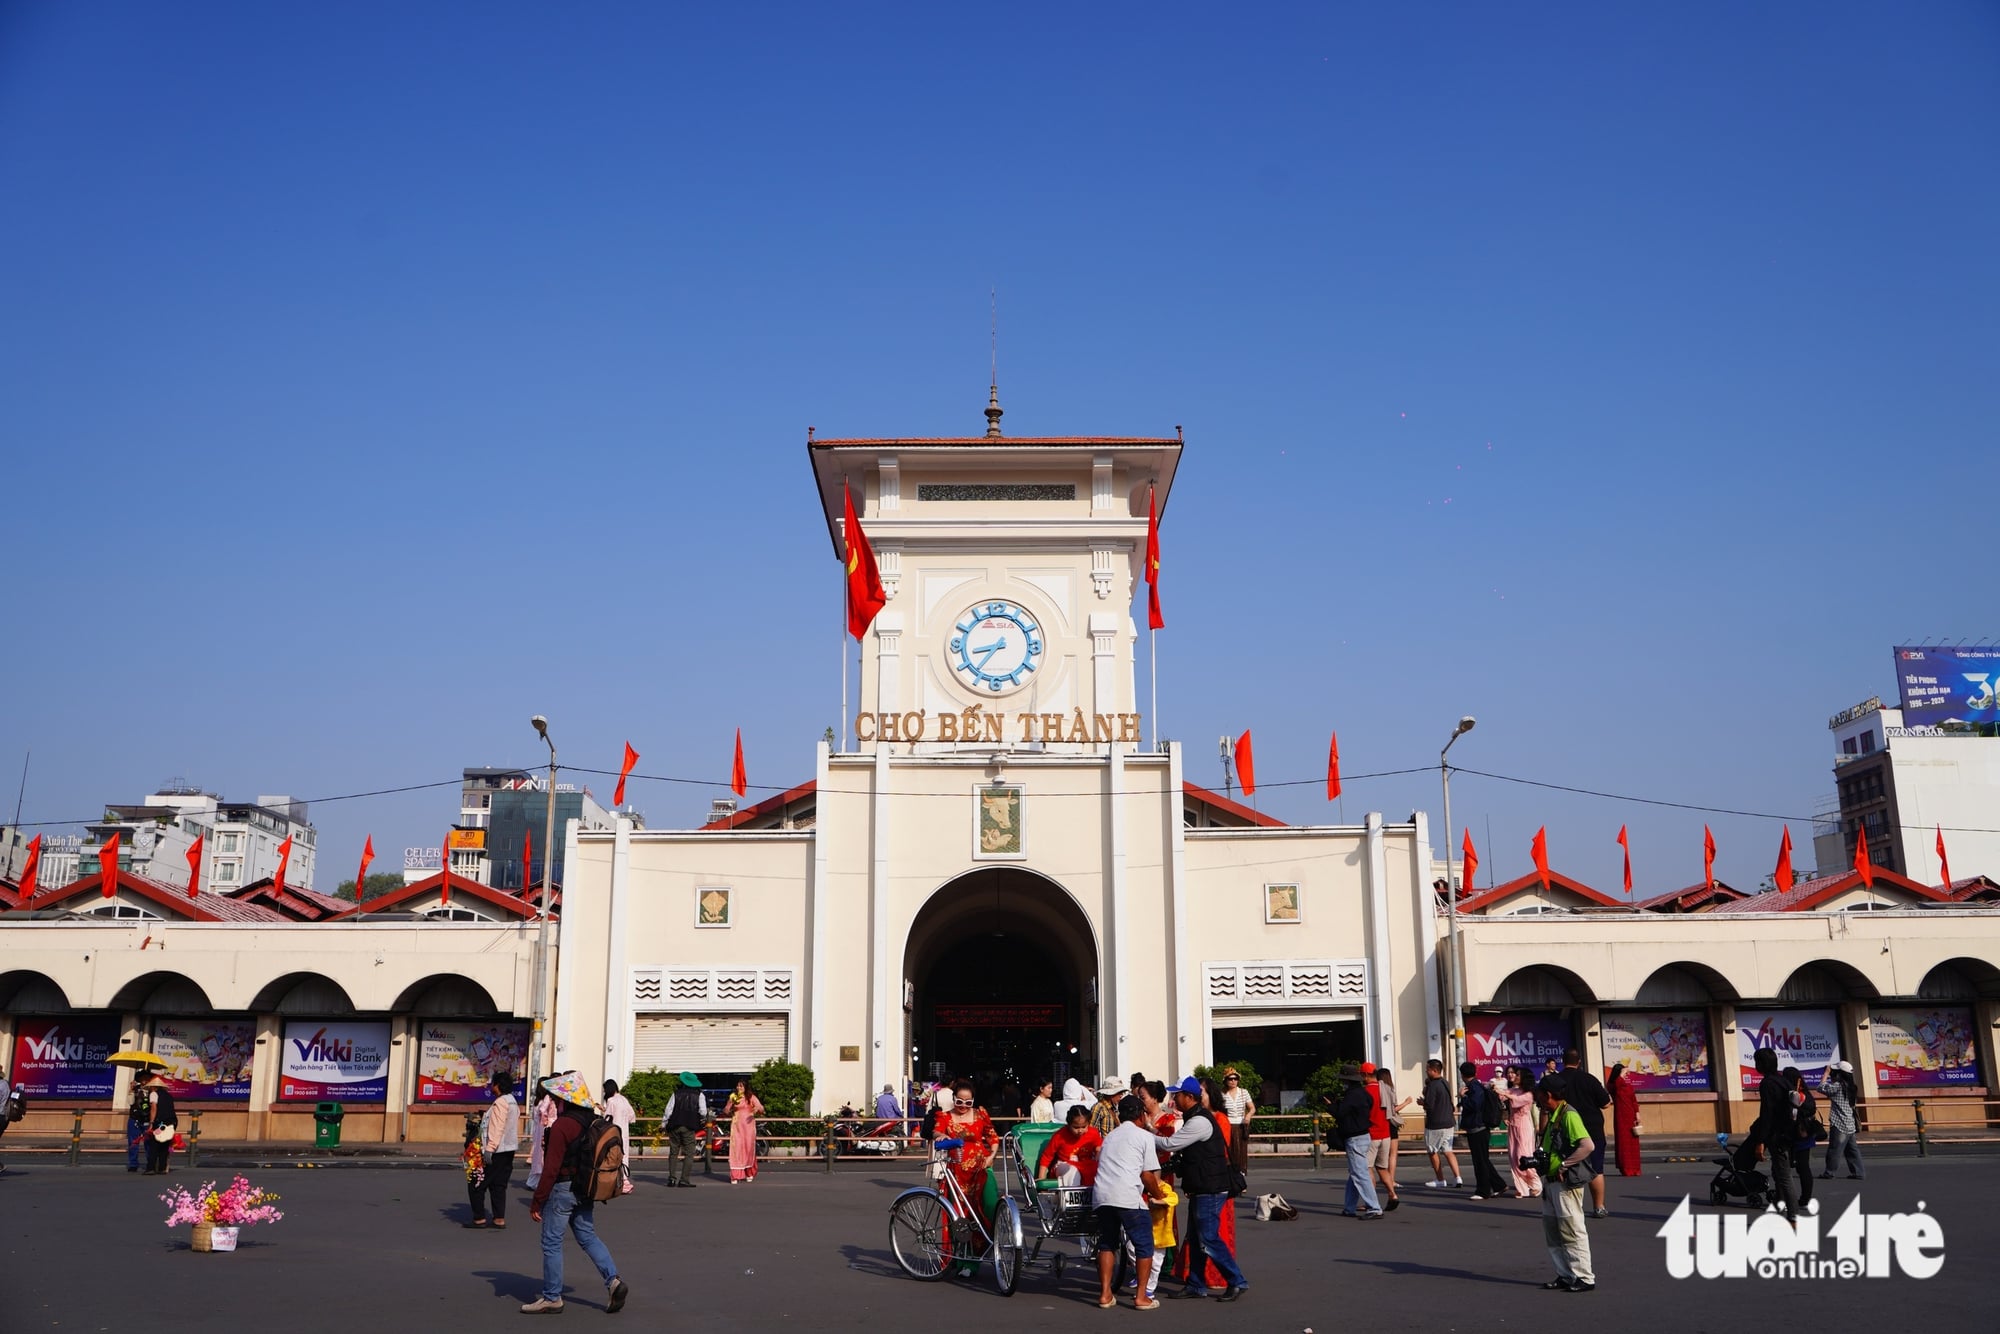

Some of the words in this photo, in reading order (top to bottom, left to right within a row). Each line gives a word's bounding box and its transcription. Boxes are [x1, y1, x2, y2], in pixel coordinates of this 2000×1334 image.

[986, 602, 1006, 616] 12
[950, 638, 963, 653] 9
[1029, 639, 1042, 655] 3
[989, 677, 1002, 691] 6
[855, 708, 926, 745] CHỢ
[938, 703, 1004, 743] BẾN
[1017, 706, 1141, 744] THÀNH
[1886, 727, 1925, 737] OZONE
[1925, 727, 1945, 737] BAR
[405, 848, 440, 858] CELEB
[404, 857, 424, 867] SPA
[1742, 1017, 1801, 1050] Vikki
[25, 1026, 83, 1060] Vikki
[293, 1027, 352, 1061] Vikki
[1473, 1022, 1534, 1056] Vikki
[1537, 1046, 1564, 1055] Bank
[1805, 1041, 1832, 1050] Bank
[354, 1053, 381, 1062] Bank
[1790, 1051, 1805, 1059] kiệm
[21, 1062, 38, 1070] Ngân
[39, 1062, 54, 1070] hàng
[56, 1061, 68, 1069] Tiết
[1475, 1058, 1491, 1066] Ngân
[1492, 1058, 1508, 1066] hàng
[1509, 1057, 1521, 1065] Tiết
[290, 1064, 307, 1072] Ngân
[308, 1064, 323, 1072] hàng
